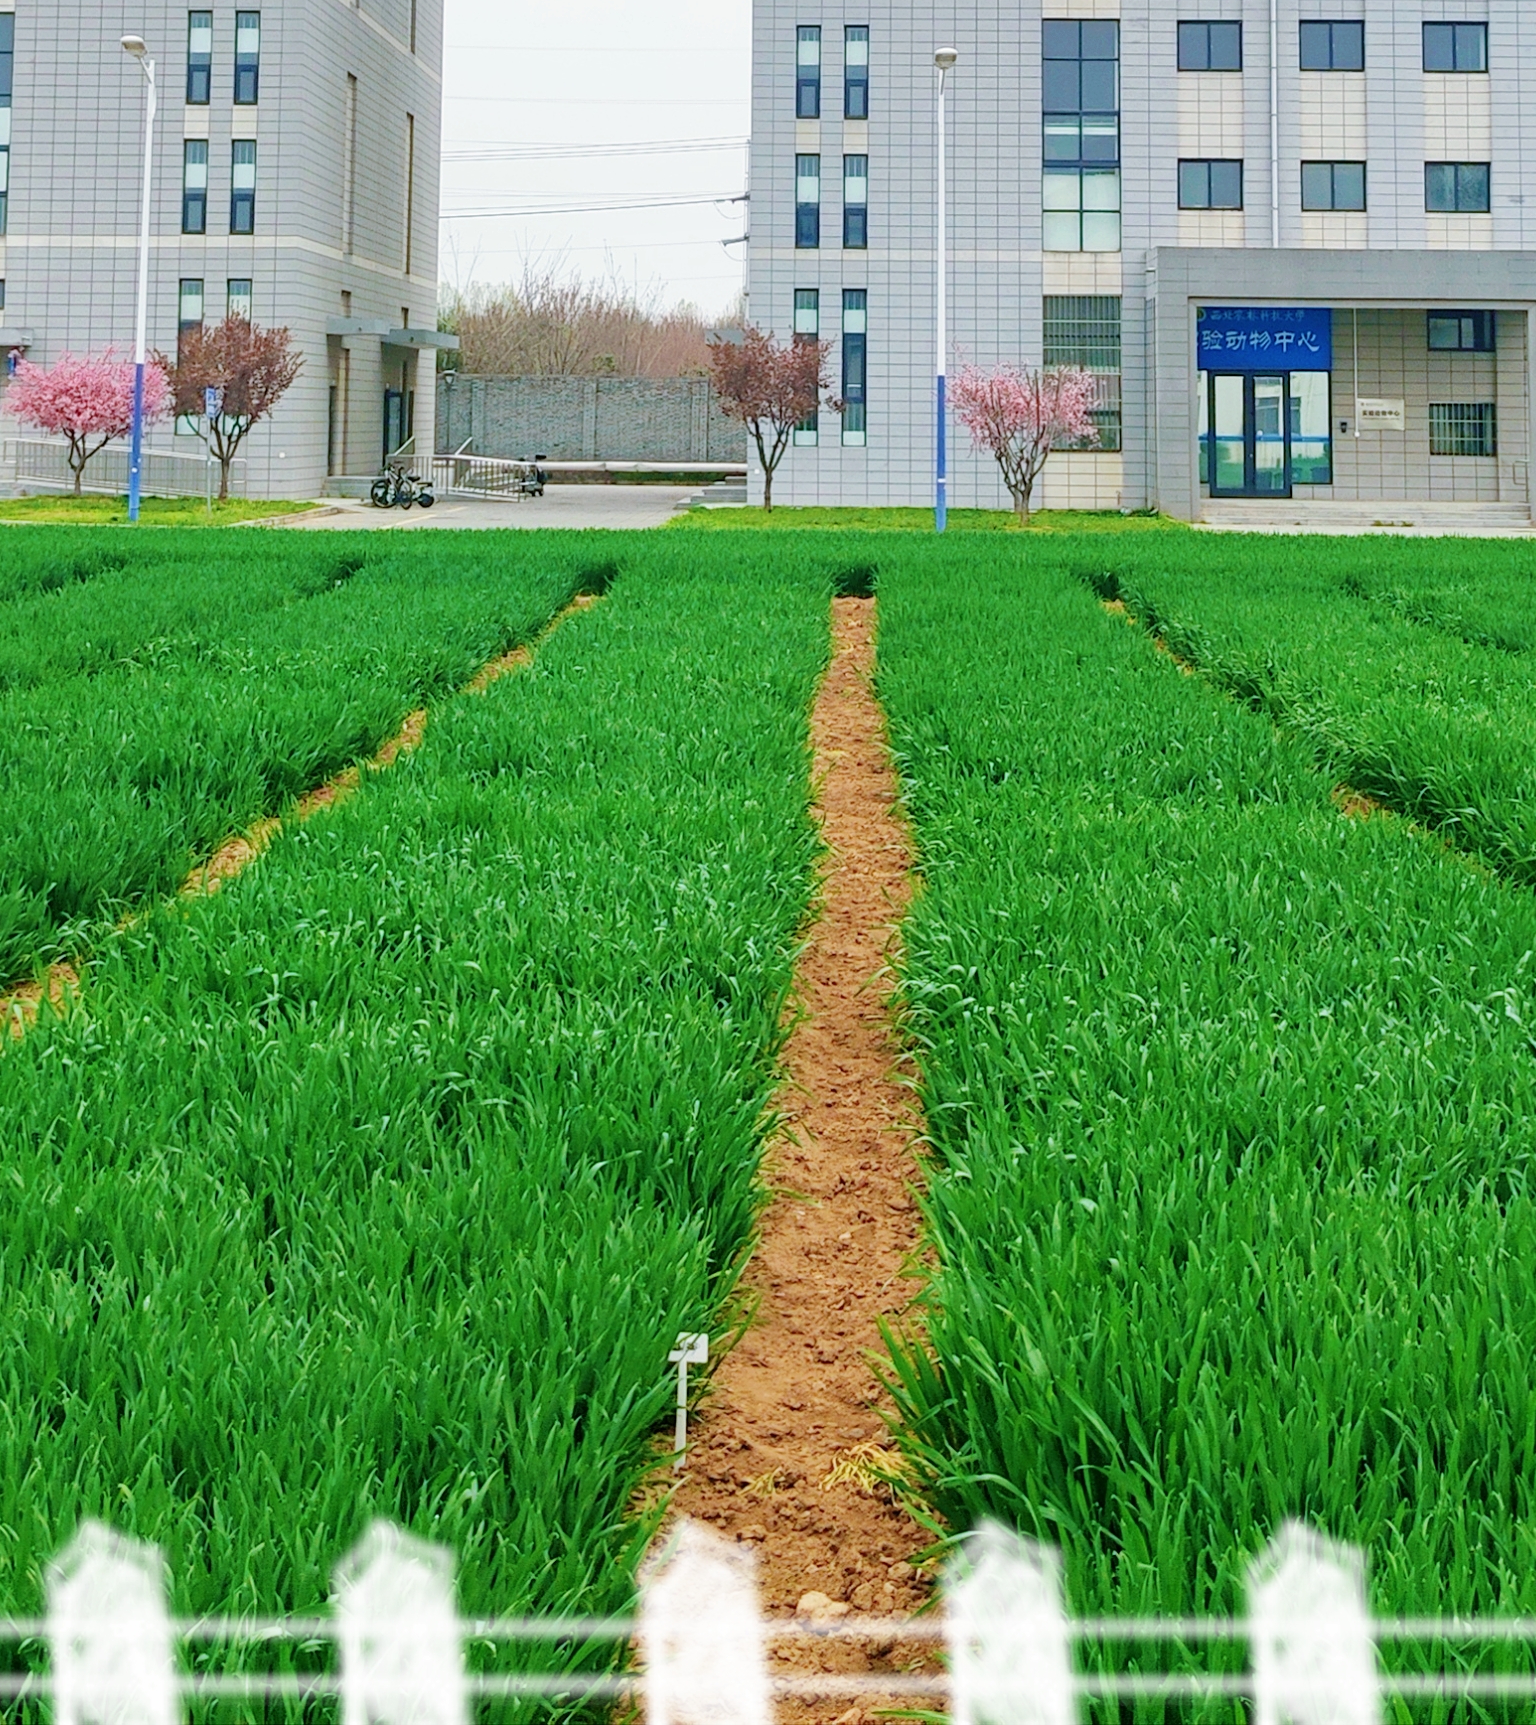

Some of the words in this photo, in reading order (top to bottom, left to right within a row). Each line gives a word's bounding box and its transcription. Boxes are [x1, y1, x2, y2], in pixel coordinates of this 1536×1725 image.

[1197, 329, 1321, 353] 验动物中心
